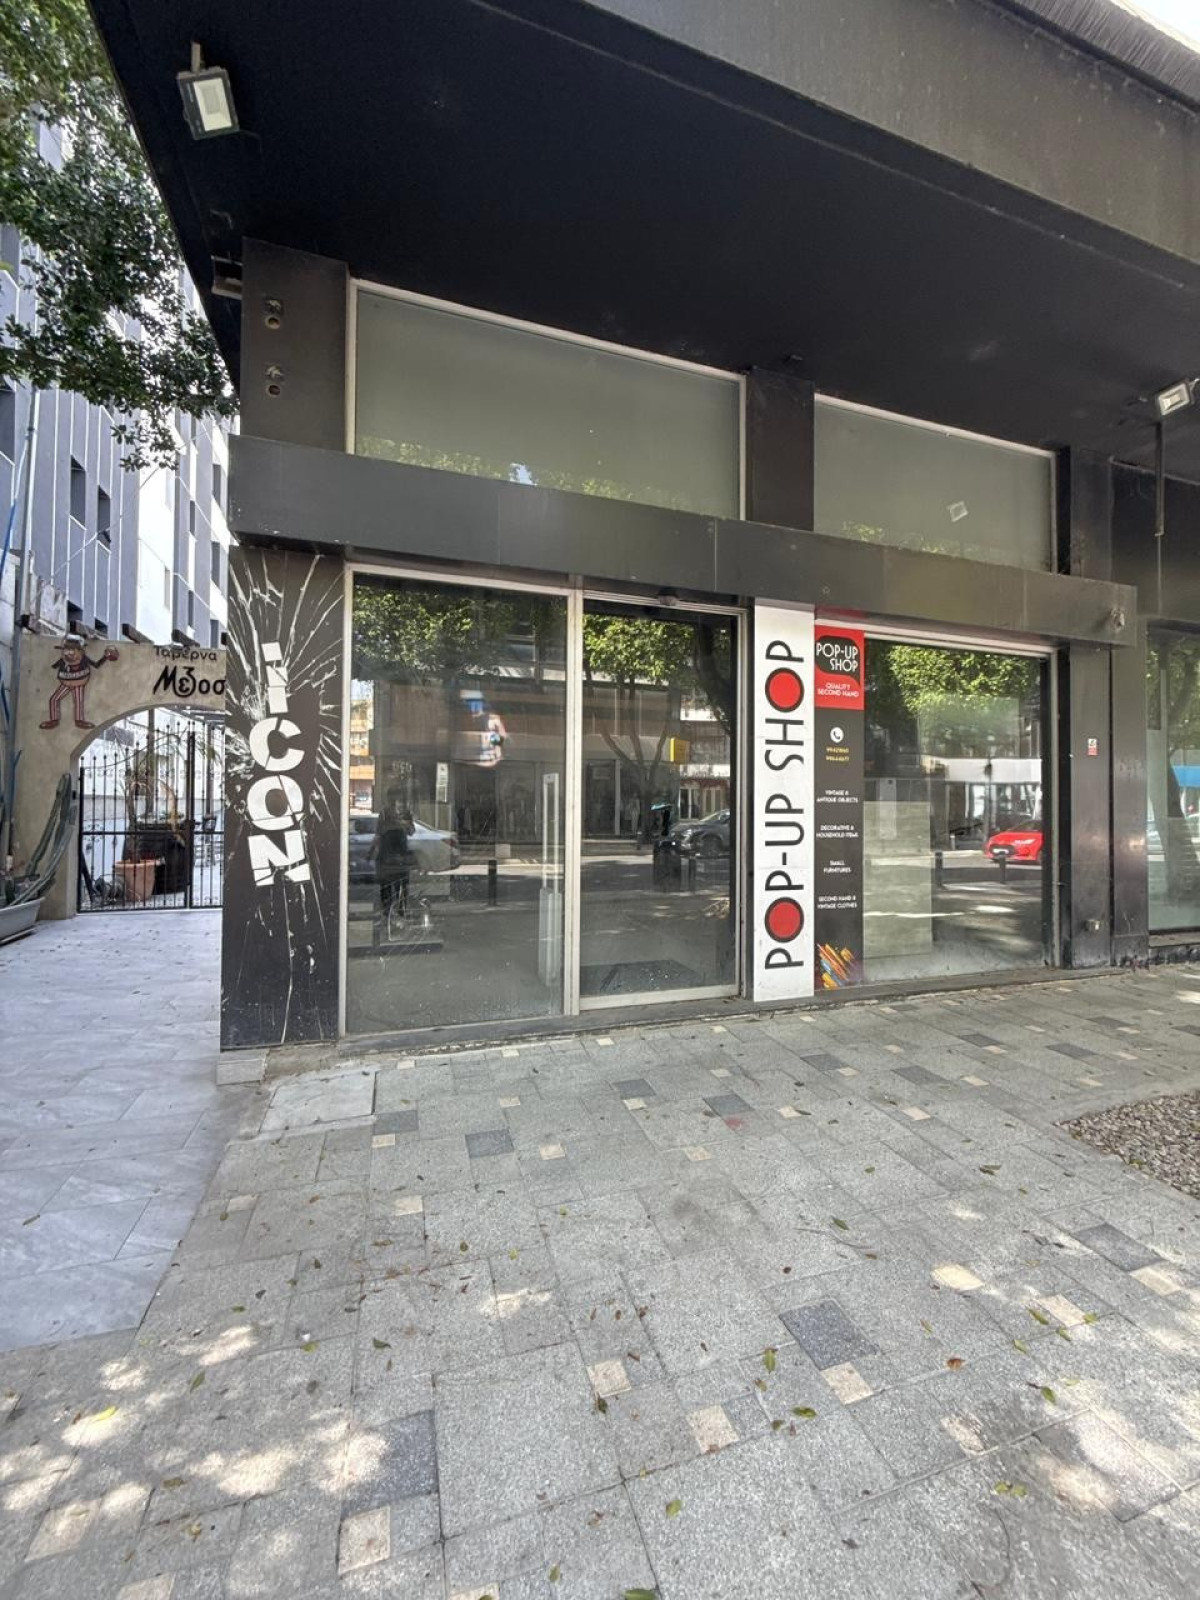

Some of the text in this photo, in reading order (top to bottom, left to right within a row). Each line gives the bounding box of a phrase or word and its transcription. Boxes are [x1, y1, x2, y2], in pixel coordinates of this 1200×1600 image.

[816, 642, 858, 660] POP-UP
[829, 658, 858, 672] SHOP
[817, 688, 860, 698] SECOND HAND
[825, 682, 851, 691] QUALITY
[765, 640, 804, 969] POP-UP SHOP
